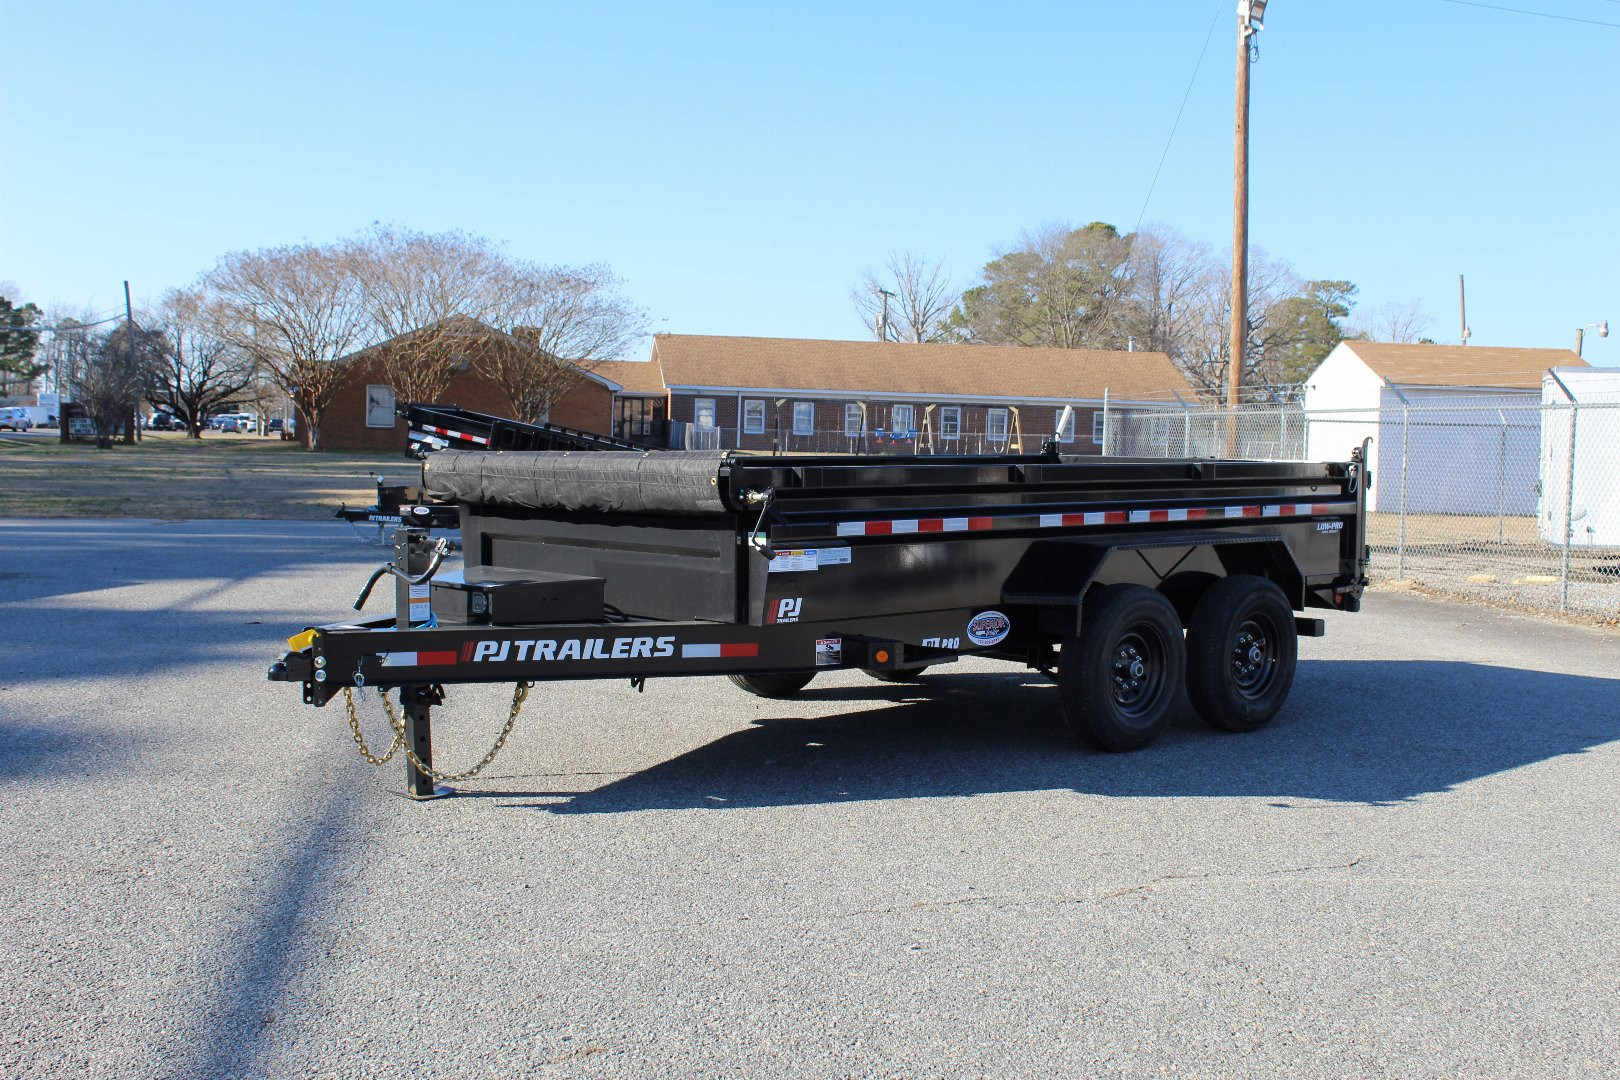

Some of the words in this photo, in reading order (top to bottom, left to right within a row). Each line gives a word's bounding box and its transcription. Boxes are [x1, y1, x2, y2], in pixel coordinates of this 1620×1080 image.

[375, 515, 402, 523] TRAILERS
[1317, 521, 1344, 530] LOW-PRO
[777, 597, 803, 618] PJ
[473, 640, 511, 662] PJ
[514, 636, 676, 662] TRAILERS
[942, 637, 959, 649] PRO
